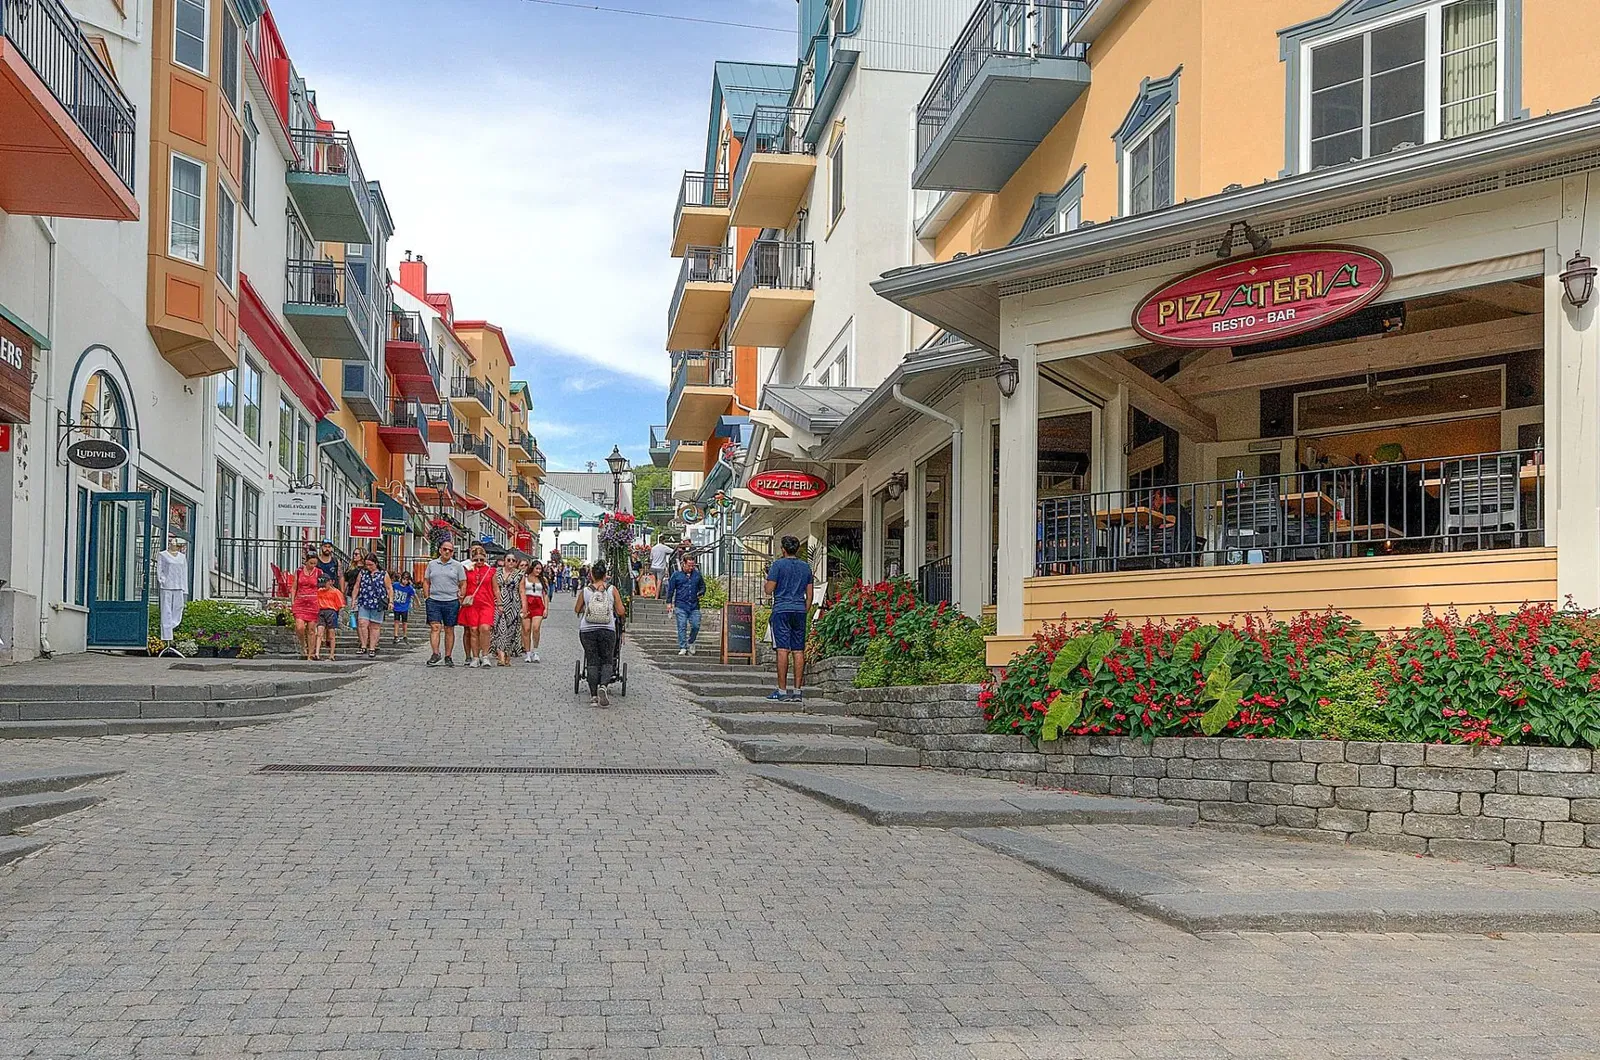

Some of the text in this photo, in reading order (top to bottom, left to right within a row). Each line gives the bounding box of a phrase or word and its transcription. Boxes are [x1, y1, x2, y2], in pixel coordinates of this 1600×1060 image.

[1157, 263, 1361, 327] PIZZATERIA
[1212, 316, 1255, 332] RESTO
[1267, 308, 1296, 324] BAR
[756, 479, 819, 491] PIZZATERIA
